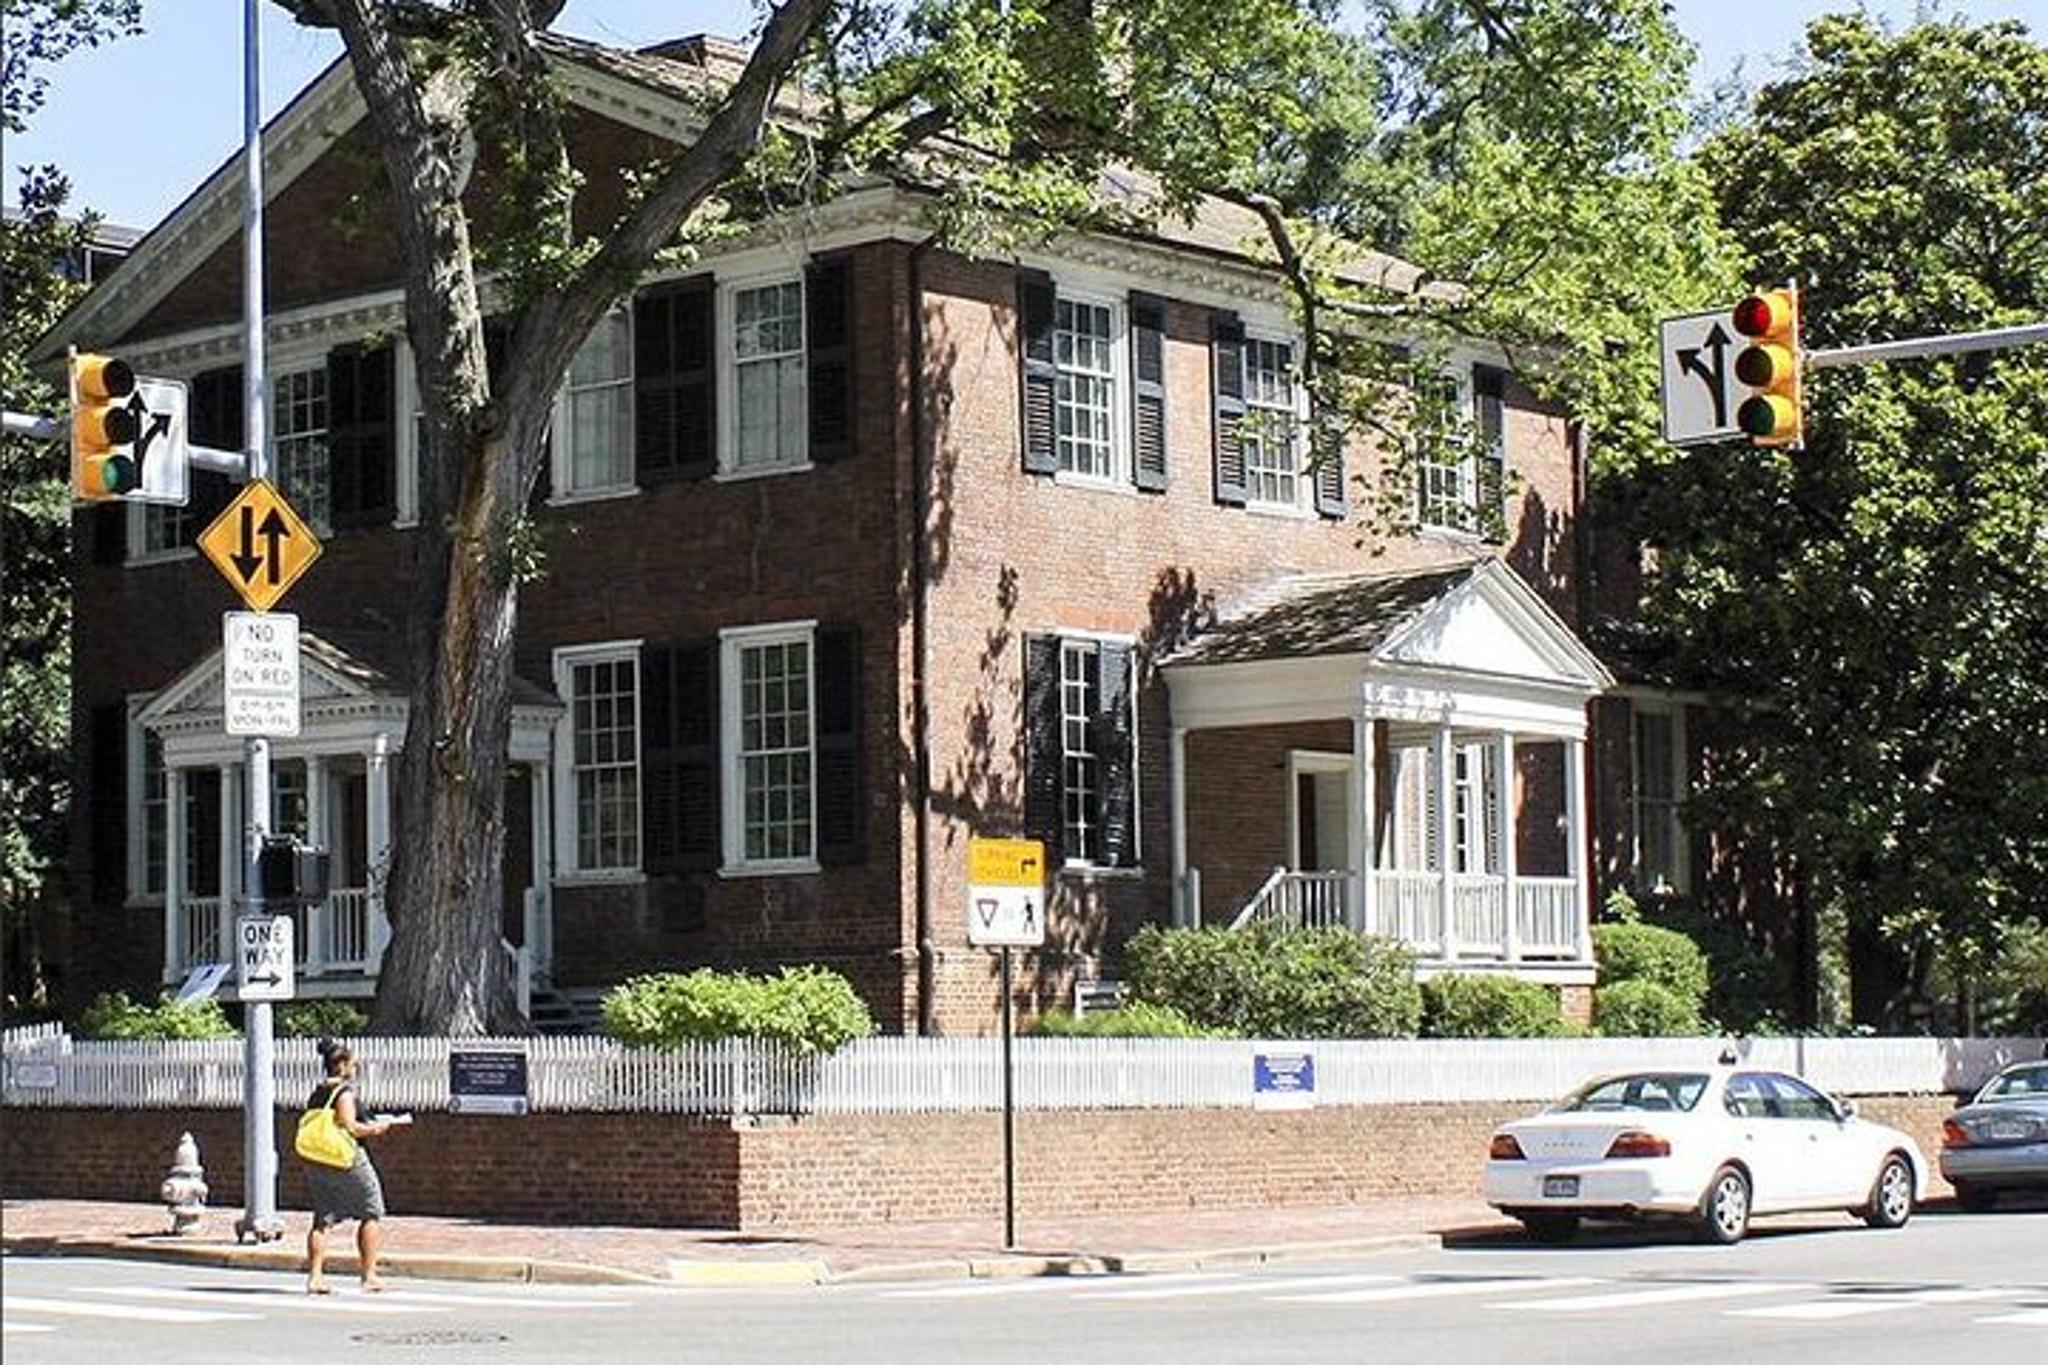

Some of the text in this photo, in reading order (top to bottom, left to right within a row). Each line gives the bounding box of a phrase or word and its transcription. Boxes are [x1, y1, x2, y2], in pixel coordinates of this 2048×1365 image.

[248, 625, 274, 642] NO
[244, 648, 282, 663] TURN
[232, 667, 291, 686] ON RED
[244, 924, 285, 945] ONE
[244, 946, 285, 965] WAY
